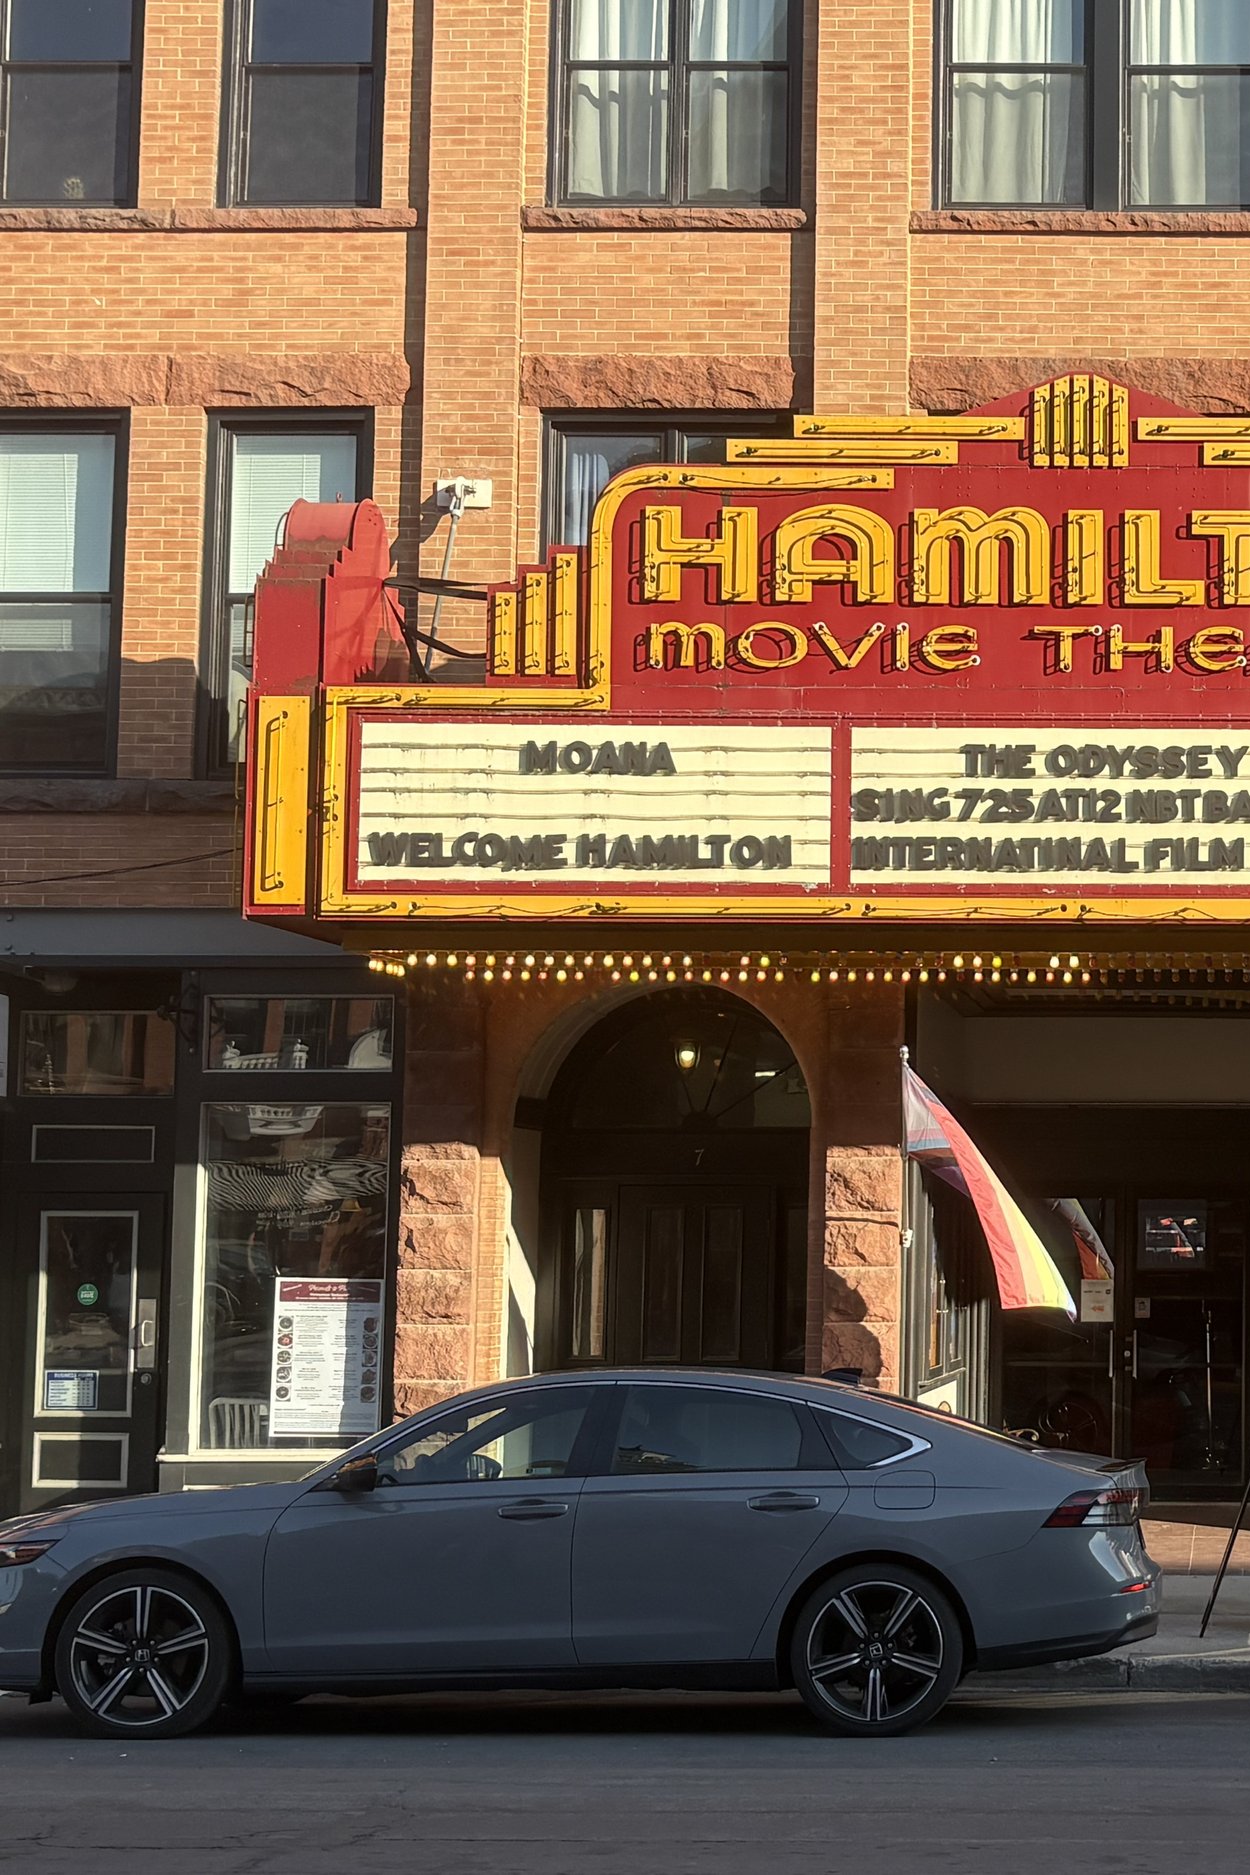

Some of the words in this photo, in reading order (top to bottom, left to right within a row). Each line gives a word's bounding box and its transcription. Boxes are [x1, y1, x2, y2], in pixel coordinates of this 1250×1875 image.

[648, 620, 981, 674] MOVIE
[519, 740, 678, 776] MOANA
[961, 743, 1037, 778] THE
[1045, 744, 1250, 779] ODYSSEY
[852, 787, 950, 823] SING
[367, 831, 568, 872] WELCOME
[576, 833, 793, 869] HAMILTON
[852, 836, 1139, 873] INTERNATINAL
[1144, 837, 1245, 873] FILM
[694, 1148, 705, 1166] 7
